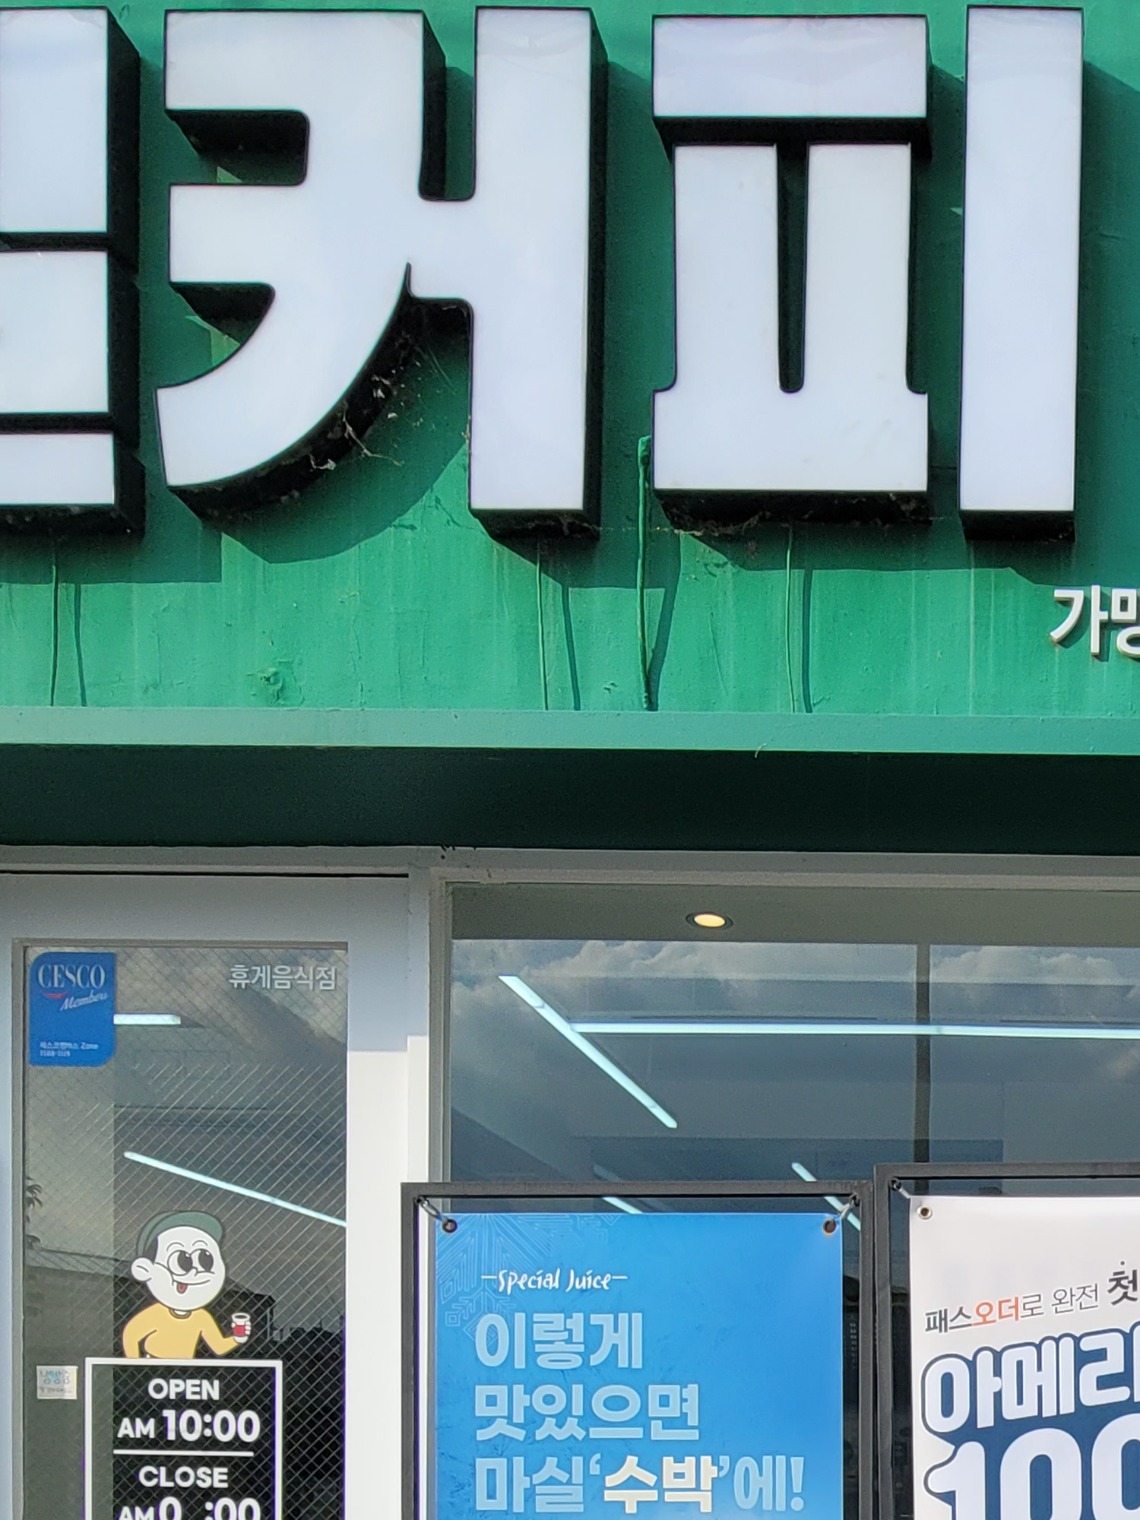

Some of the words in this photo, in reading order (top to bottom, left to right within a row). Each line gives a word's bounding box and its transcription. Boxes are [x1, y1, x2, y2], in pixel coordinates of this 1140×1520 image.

[38, 964, 105, 989] CESCO
[228, 964, 338, 991] 휴게음식점
[498, 1267, 561, 1295] Special
[565, 1269, 612, 1293] Juice
[924, 1291, 1044, 1334] 패스오더로
[1051, 1284, 1099, 1314] 완전
[1108, 1269, 1139, 1306] 첫
[474, 1312, 643, 1369] 이렇게
[148, 1378, 220, 1400] OPEN
[117, 1416, 155, 1439] AM
[161, 1409, 261, 1443] 10:00
[474, 1383, 700, 1441] 맛있으면
[138, 1465, 229, 1488] CLOSE
